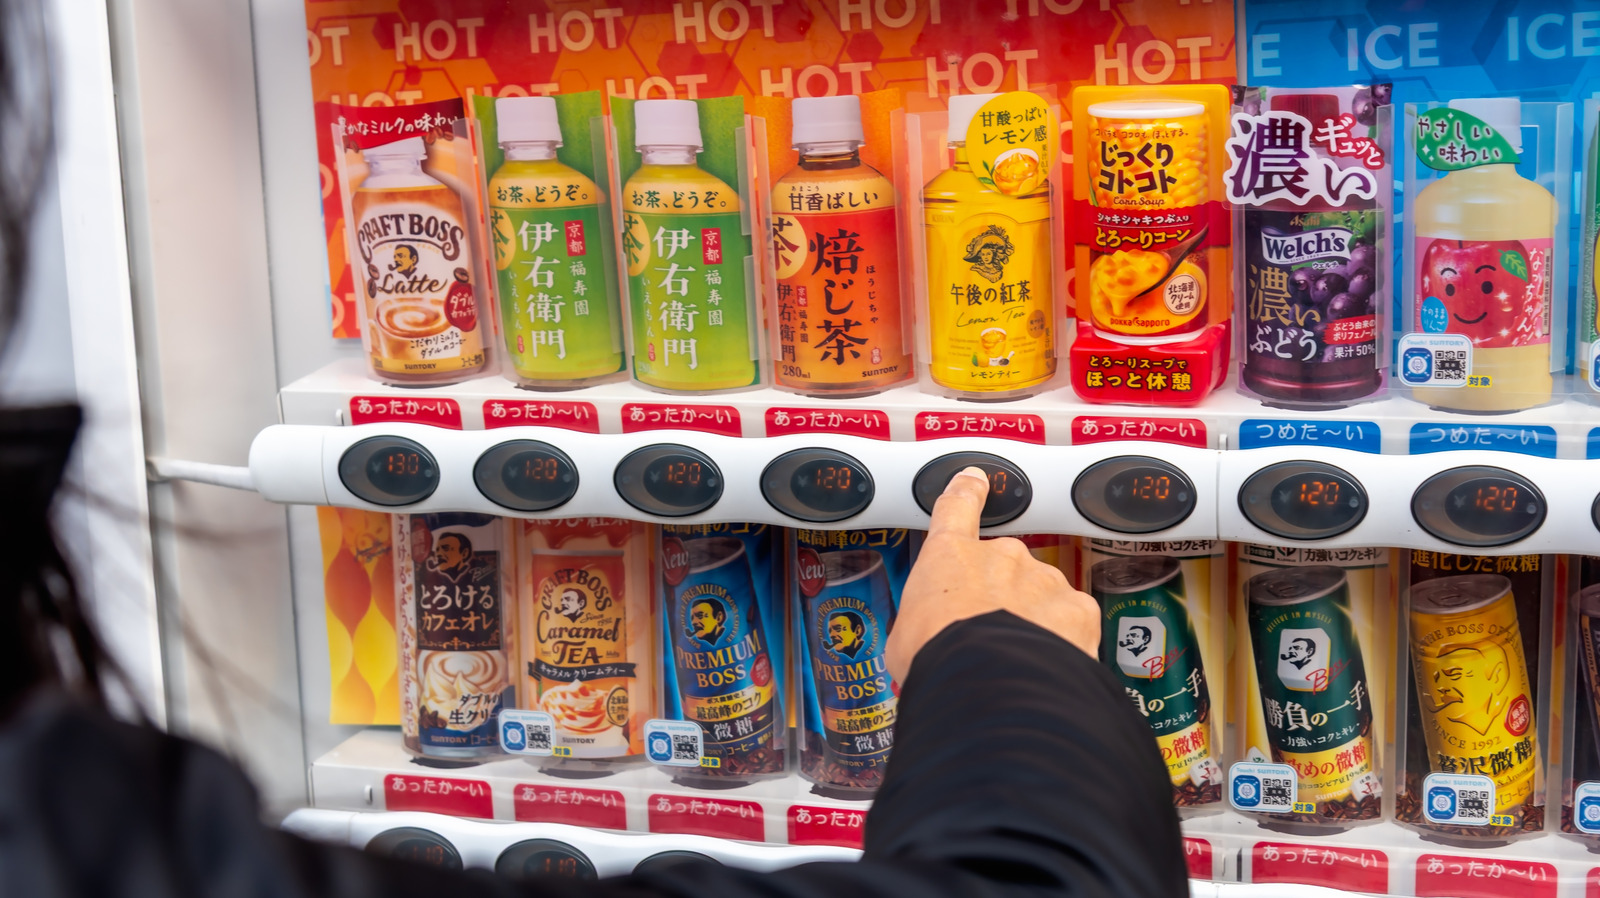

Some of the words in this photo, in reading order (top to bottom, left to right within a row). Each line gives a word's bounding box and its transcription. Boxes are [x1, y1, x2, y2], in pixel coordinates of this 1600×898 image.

[529, 10, 624, 54] HOT
[674, 0, 775, 43] HOT
[394, 18, 485, 62] HOT
[1347, 23, 1440, 71] ICE
[1508, 11, 1600, 61] ICE
[1095, 37, 1212, 85] HOT
[761, 62, 872, 97] HOT
[926, 49, 1039, 97] HOT
[979, 107, 1047, 127] 甘酸っぱい
[1418, 117, 1492, 140] やさしい
[983, 125, 1047, 145] レモン感
[1314, 117, 1384, 167] ギュッと
[1101, 141, 1174, 168] じっくり
[1229, 117, 1372, 201] 濃い
[1439, 146, 1502, 164] 味わい
[1098, 169, 1177, 194] コトコト
[497, 184, 588, 203] お茶、どうぞ。
[632, 190, 727, 209] お茶、どうぞ。
[788, 192, 878, 211] 甘香ばしい
[1114, 196, 1138, 205] Corn
[1139, 197, 1165, 207] Soup
[1097, 213, 1190, 225] シャキシャキつぶ入り
[1290, 215, 1320, 227] Asahi
[358, 214, 405, 264] CRAFT
[408, 214, 464, 261] BOSS
[567, 222, 585, 254] 京都
[704, 230, 720, 263] 京都
[1264, 232, 1345, 260] Welch's
[1312, 261, 1339, 269] ウェルチ
[377, 273, 448, 295] Latte
[518, 220, 566, 360] 伊右衛門
[569, 261, 589, 316] 福寿園
[951, 280, 1030, 306] 午後の紅茶
[1168, 282, 1194, 294] 北海道
[1249, 264, 1321, 327] 濃い
[652, 226, 700, 370] 伊右衛門
[705, 269, 723, 326] 福寿園
[798, 286, 807, 306] 京都
[809, 228, 869, 365] 焙じ茶
[1170, 293, 1194, 305] クリーム
[777, 283, 796, 363] 伊右衛門
[957, 312, 998, 327] Lemon
[1002, 306, 1026, 323] Tea
[1333, 320, 1376, 331] ぶどう由来の
[1250, 324, 1317, 361] ぶどう
[1334, 346, 1354, 358] 果汁
[1356, 344, 1376, 357] 50%
[782, 365, 811, 379] 280ml
[861, 365, 898, 378] SUNTORY
[971, 370, 1020, 379] レモンティー
[1086, 371, 1192, 391] ほっと休憩
[1469, 375, 1490, 386] 対象
[388, 453, 419, 475] 130
[525, 458, 558, 480] 120
[668, 462, 701, 485] 120
[816, 467, 851, 490] 120
[1133, 476, 1170, 499] 120
[1301, 481, 1340, 505] 120
[1477, 486, 1517, 511] 120
[1305, 548, 1382, 562] 力強いコクとキレ
[1412, 550, 1540, 573] 進化した微糖
[420, 584, 494, 610] とろける
[541, 569, 575, 611] CRAFT
[576, 569, 612, 612] BOSS
[682, 584, 727, 604] PREMIUM
[819, 597, 865, 617] PREMIUM
[422, 611, 494, 632] カフェオレ
[537, 610, 621, 644] Caramel
[1446, 624, 1484, 636] BOSS
[552, 640, 603, 665] TEA
[676, 629, 762, 669] PREMIUM
[696, 664, 747, 688] BOSS
[814, 654, 886, 682] PREMIU
[835, 676, 887, 700] BOSS
[696, 691, 762, 719] 最高峰のコク
[1264, 680, 1365, 731] 勝負の一手
[449, 709, 496, 725] 生クリー
[713, 716, 754, 740] 微糖
[836, 710, 895, 732] 最高峰のコ
[1432, 719, 1466, 749] SINCE
[1472, 736, 1502, 750] 1992
[727, 743, 755, 755] コーヒー
[1437, 735, 1533, 775] 贅沢微糖
[796, 809, 864, 828] あったか
[1294, 803, 1315, 813] 対象
[1491, 815, 1512, 825] 対象
